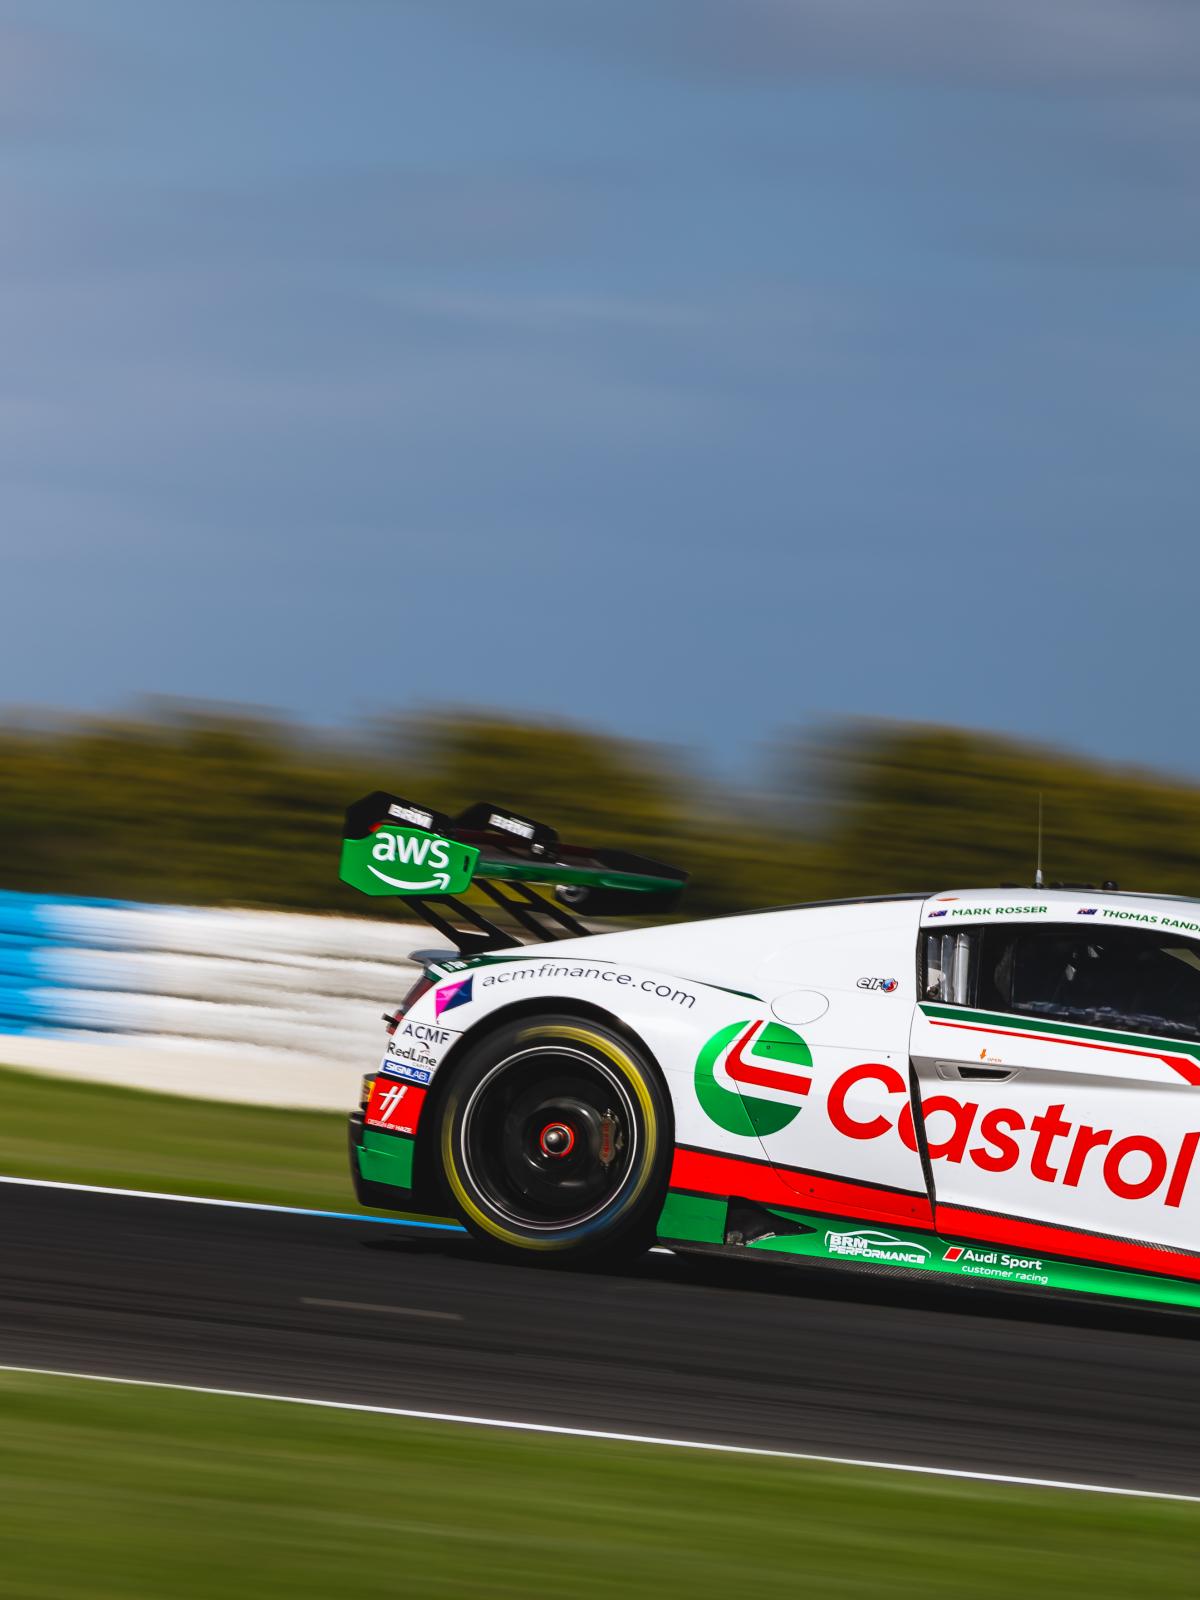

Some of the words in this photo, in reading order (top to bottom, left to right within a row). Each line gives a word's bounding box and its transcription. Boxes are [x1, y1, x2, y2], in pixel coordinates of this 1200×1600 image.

[372, 832, 450, 869] aws
[952, 907, 992, 917] MARK
[995, 906, 1048, 915] ROSSER
[1102, 909, 1158, 924] THOMAS
[482, 964, 697, 1009] acmfinance.com
[857, 977, 884, 991] elf
[403, 1023, 450, 1045] ACMF
[387, 1041, 437, 1067] RedLine
[829, 1234, 869, 1248] BRM
[829, 1245, 926, 1265] PERFORMANCE
[963, 1250, 998, 1265] Audi
[1000, 1255, 1043, 1271] Sport
[961, 1264, 1014, 1279] customer
[1015, 1272, 1049, 1285] racing
